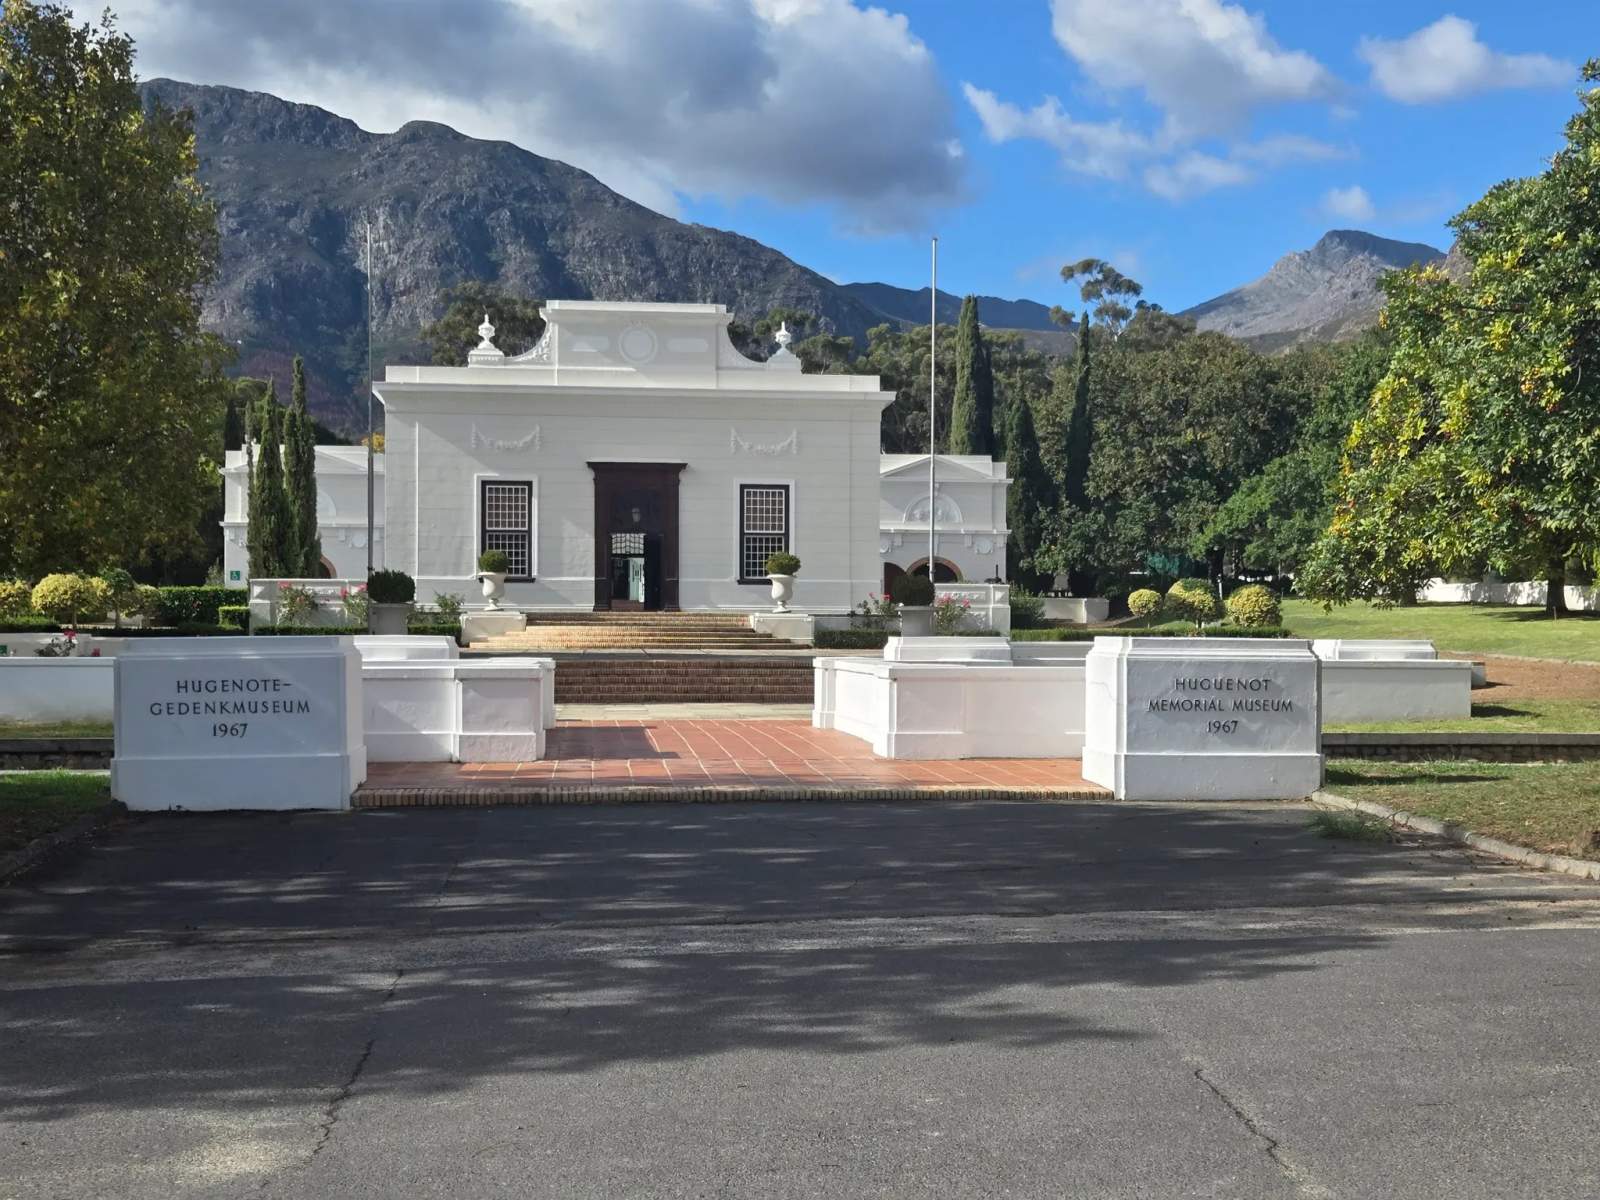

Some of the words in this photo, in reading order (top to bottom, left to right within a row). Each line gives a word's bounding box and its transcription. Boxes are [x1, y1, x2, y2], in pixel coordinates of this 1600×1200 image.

[1175, 678, 1271, 691] HUGUENOT
[150, 700, 311, 716] GEDENKMUSEUM
[1148, 699, 1225, 713] MEMORIAL
[1232, 699, 1293, 712] MUSEUM
[212, 723, 248, 738] 1967
[1207, 720, 1239, 734] 1967
